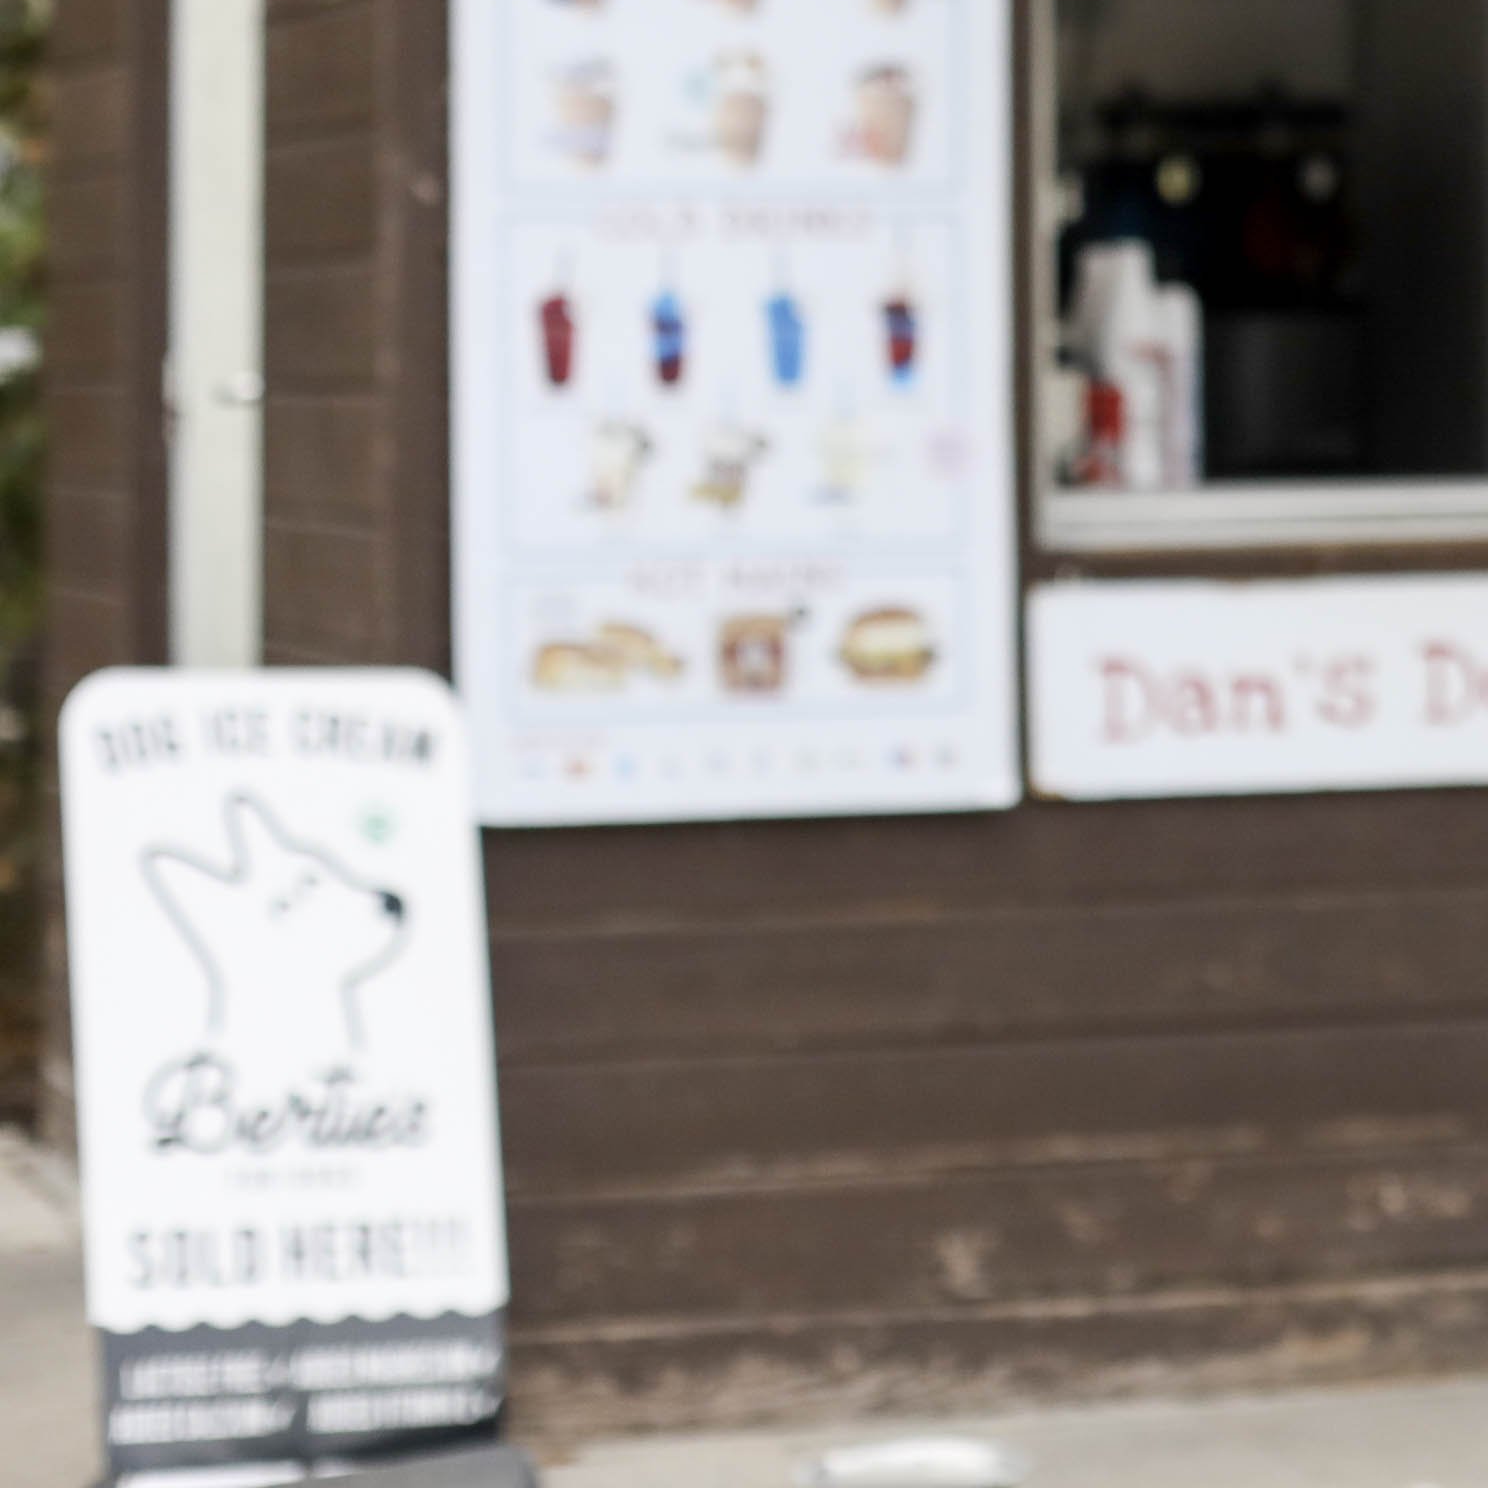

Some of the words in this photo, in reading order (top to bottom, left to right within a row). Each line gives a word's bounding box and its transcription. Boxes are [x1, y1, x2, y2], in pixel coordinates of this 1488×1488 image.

[211, 709, 271, 759] ICE
[293, 709, 438, 767] CREAM
[128, 1225, 264, 1289] SOLD
